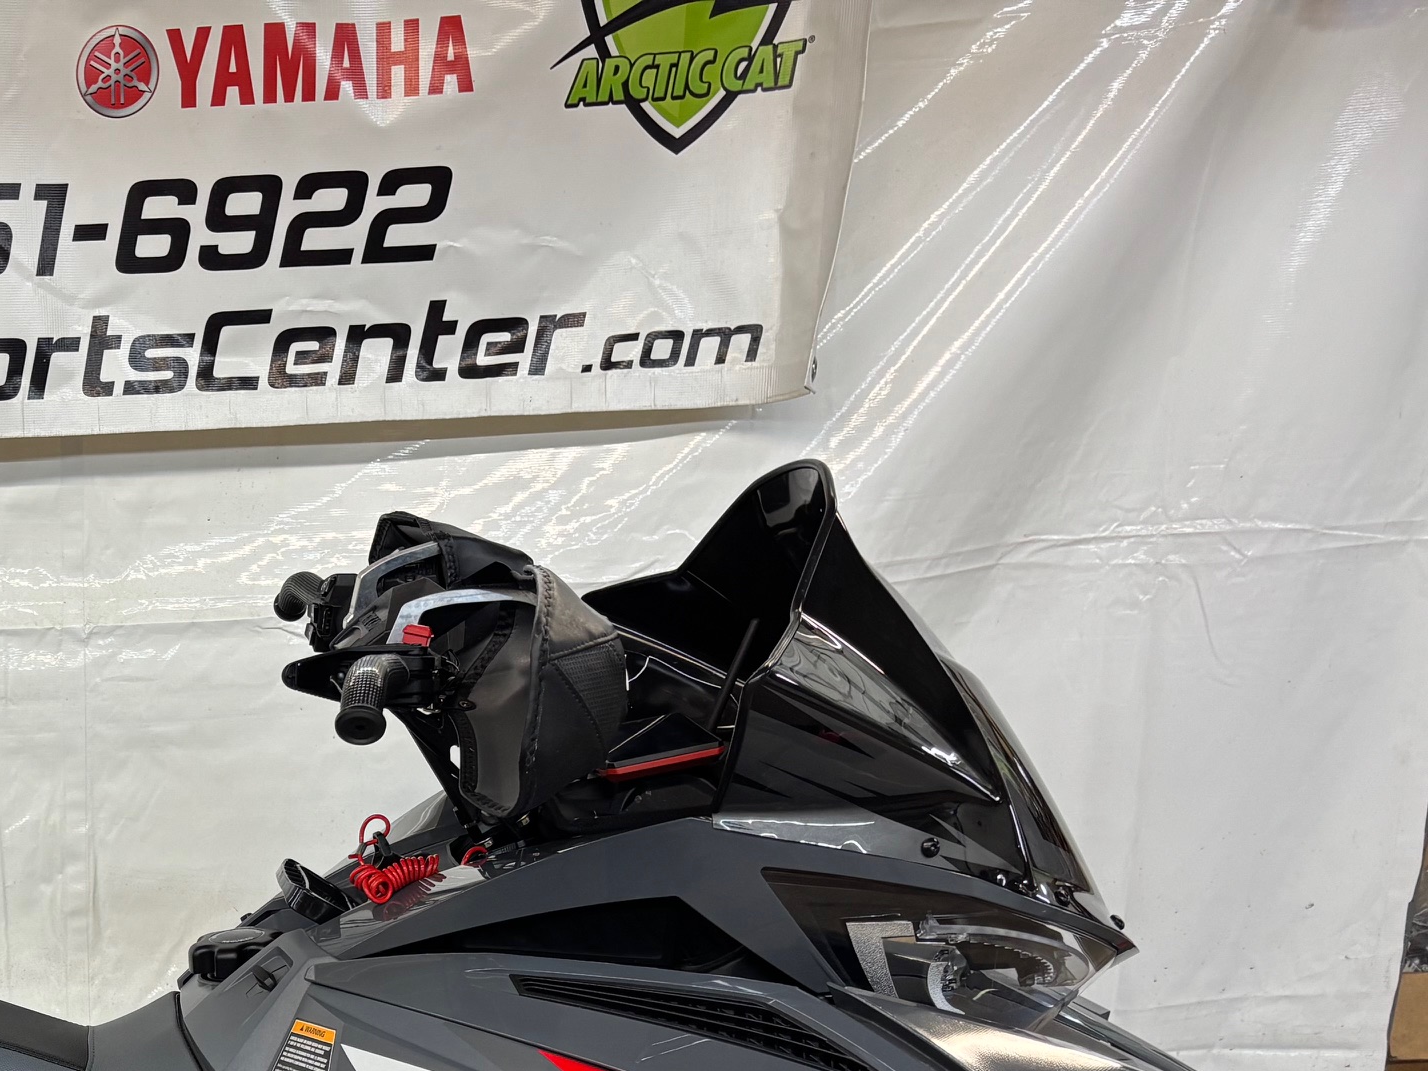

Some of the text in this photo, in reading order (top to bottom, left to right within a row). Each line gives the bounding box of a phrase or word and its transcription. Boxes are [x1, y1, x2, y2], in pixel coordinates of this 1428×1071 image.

[165, 14, 477, 109] YAMAHA
[565, 38, 807, 108] ARCTIC CAT
[304, 1026, 327, 1038] WARNING
